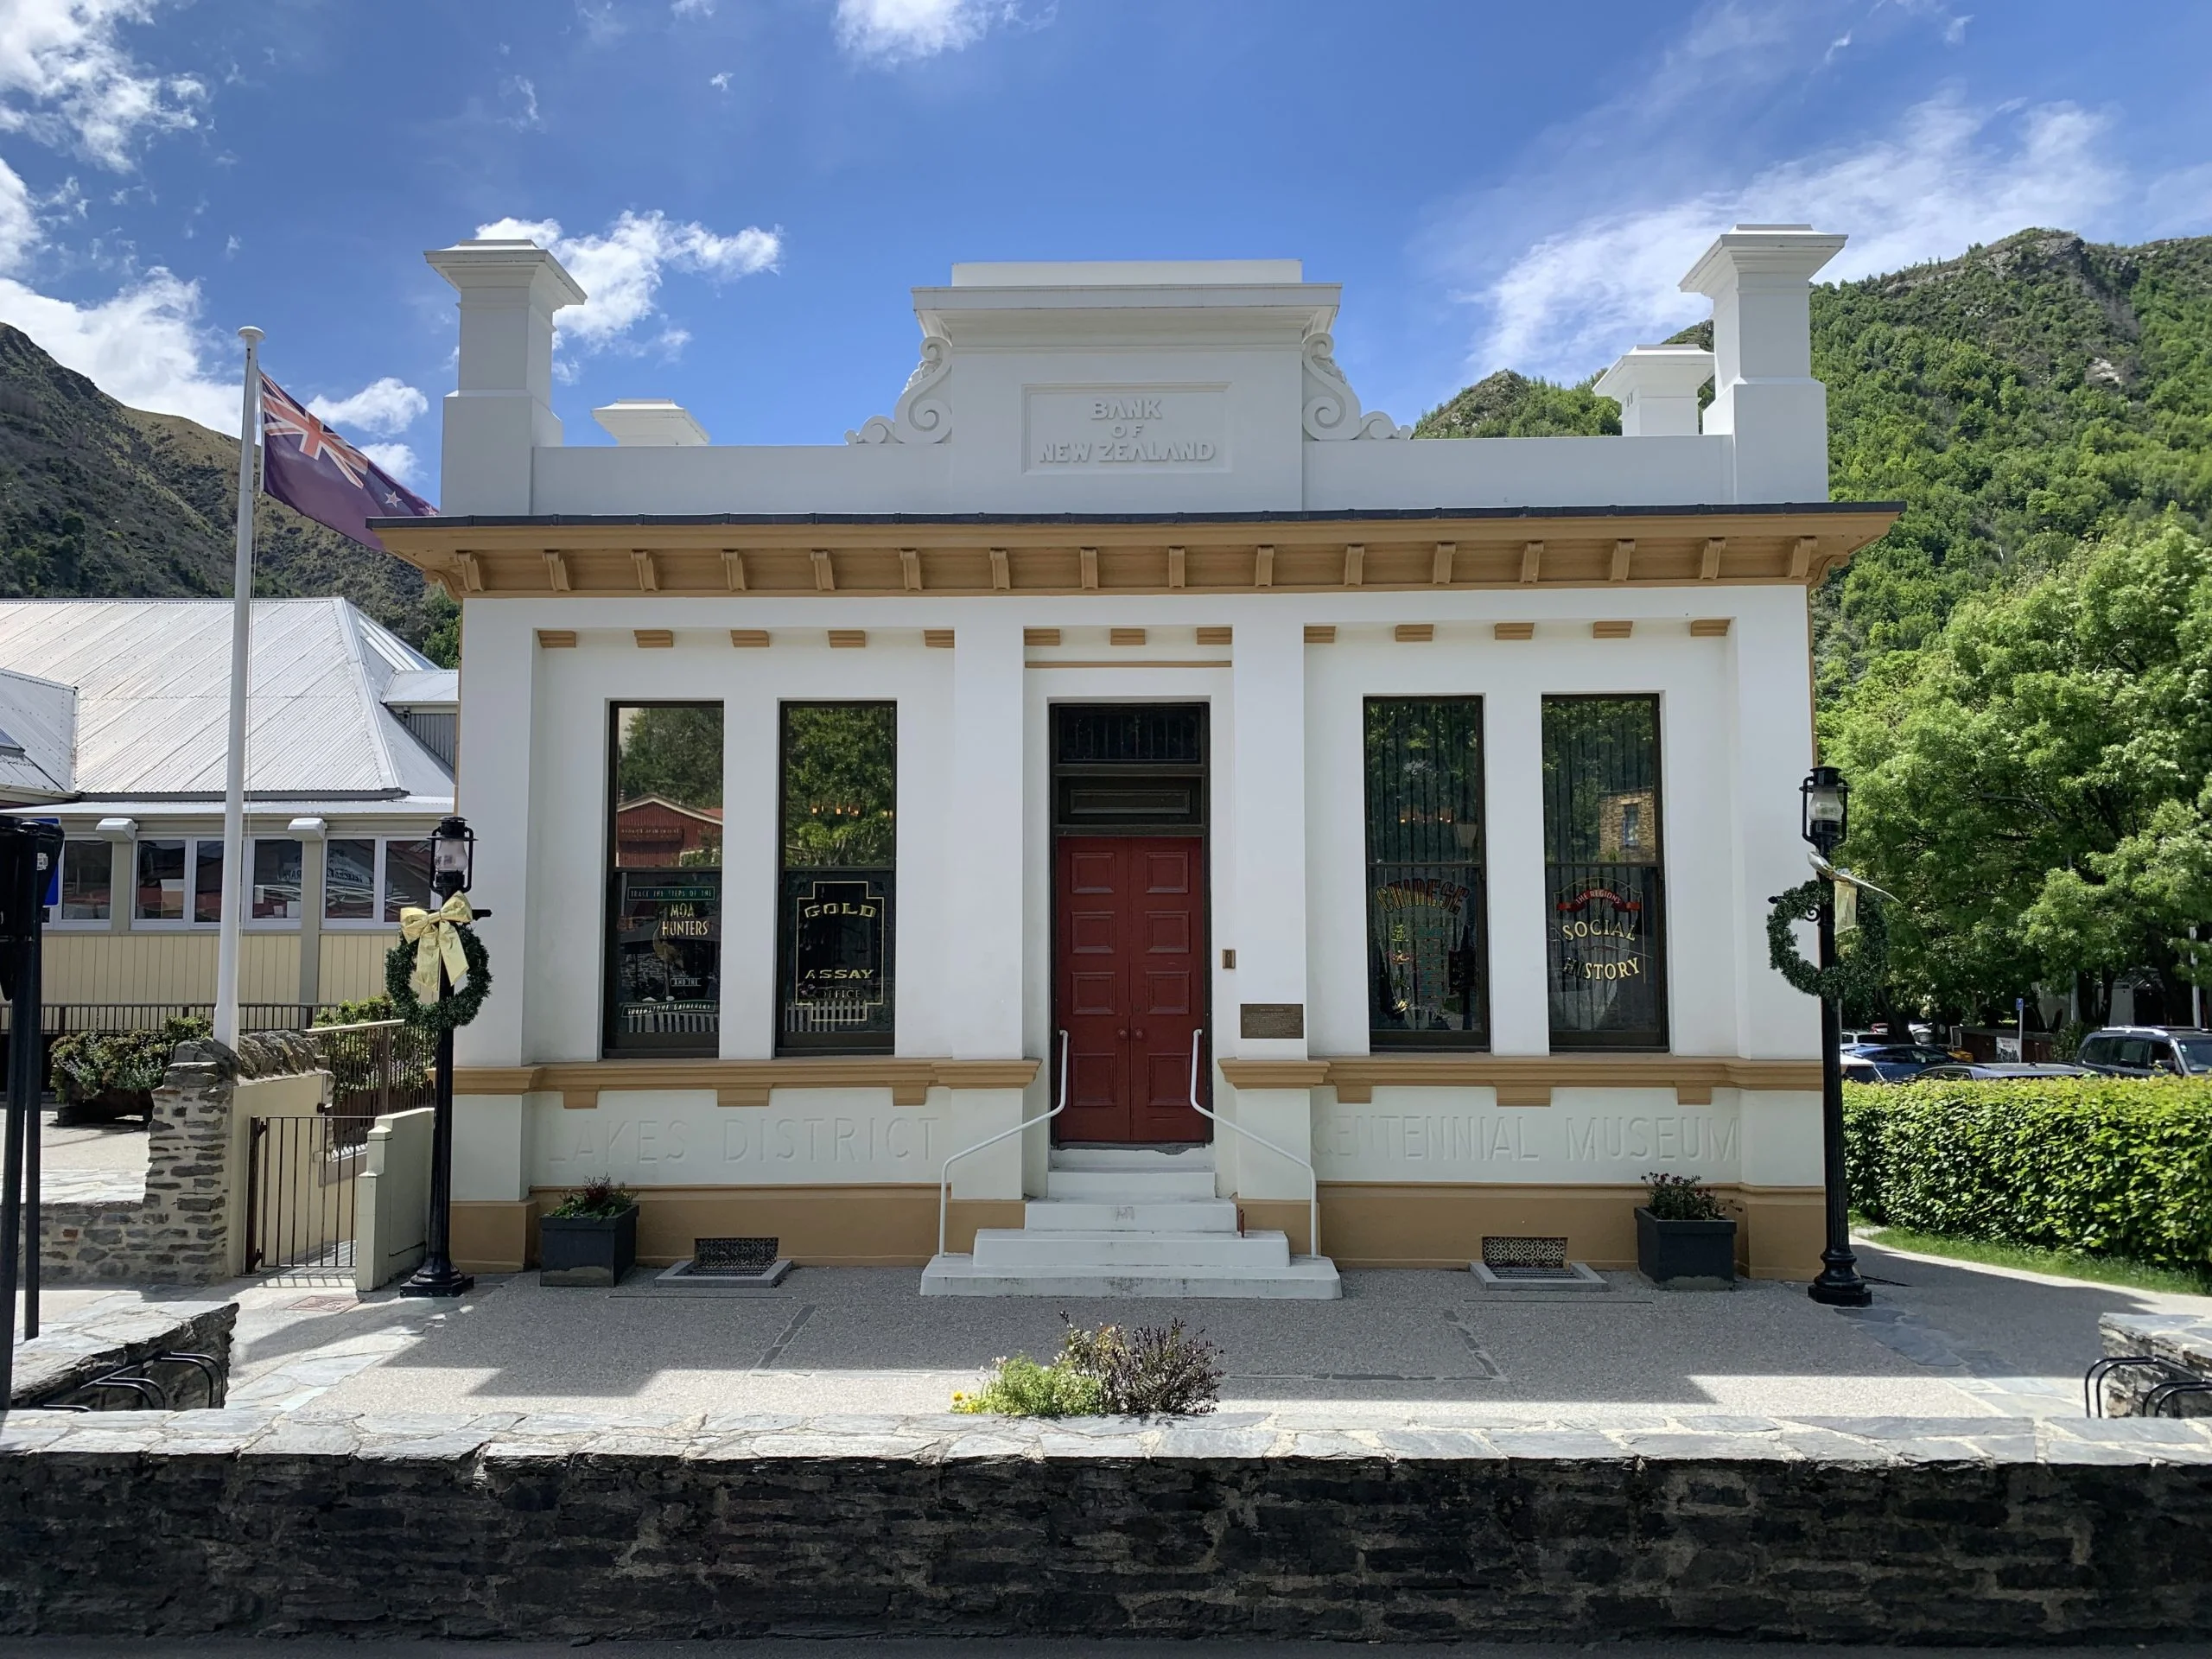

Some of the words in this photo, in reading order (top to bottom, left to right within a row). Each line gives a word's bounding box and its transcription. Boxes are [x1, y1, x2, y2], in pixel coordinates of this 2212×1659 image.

[1090, 399, 1163, 420] BANK
[1111, 424, 1144, 439] OF
[1039, 443, 1092, 463] NEW
[1098, 442, 1217, 462] ZEALAND
[701, 889, 713, 898] THE
[1575, 892, 1589, 905] THE
[670, 902, 696, 918] MOA
[804, 902, 877, 918] GOLD
[662, 920, 709, 936] HUNTERS
[1562, 918, 1637, 942] SOCIAL
[804, 969, 874, 979] ASSAY
[1562, 957, 1641, 981] HISTORY
[546, 1119, 690, 1165] LAKES
[721, 1116, 941, 1164] DISTRICT
[1566, 1116, 1741, 1163] MUSEUM
